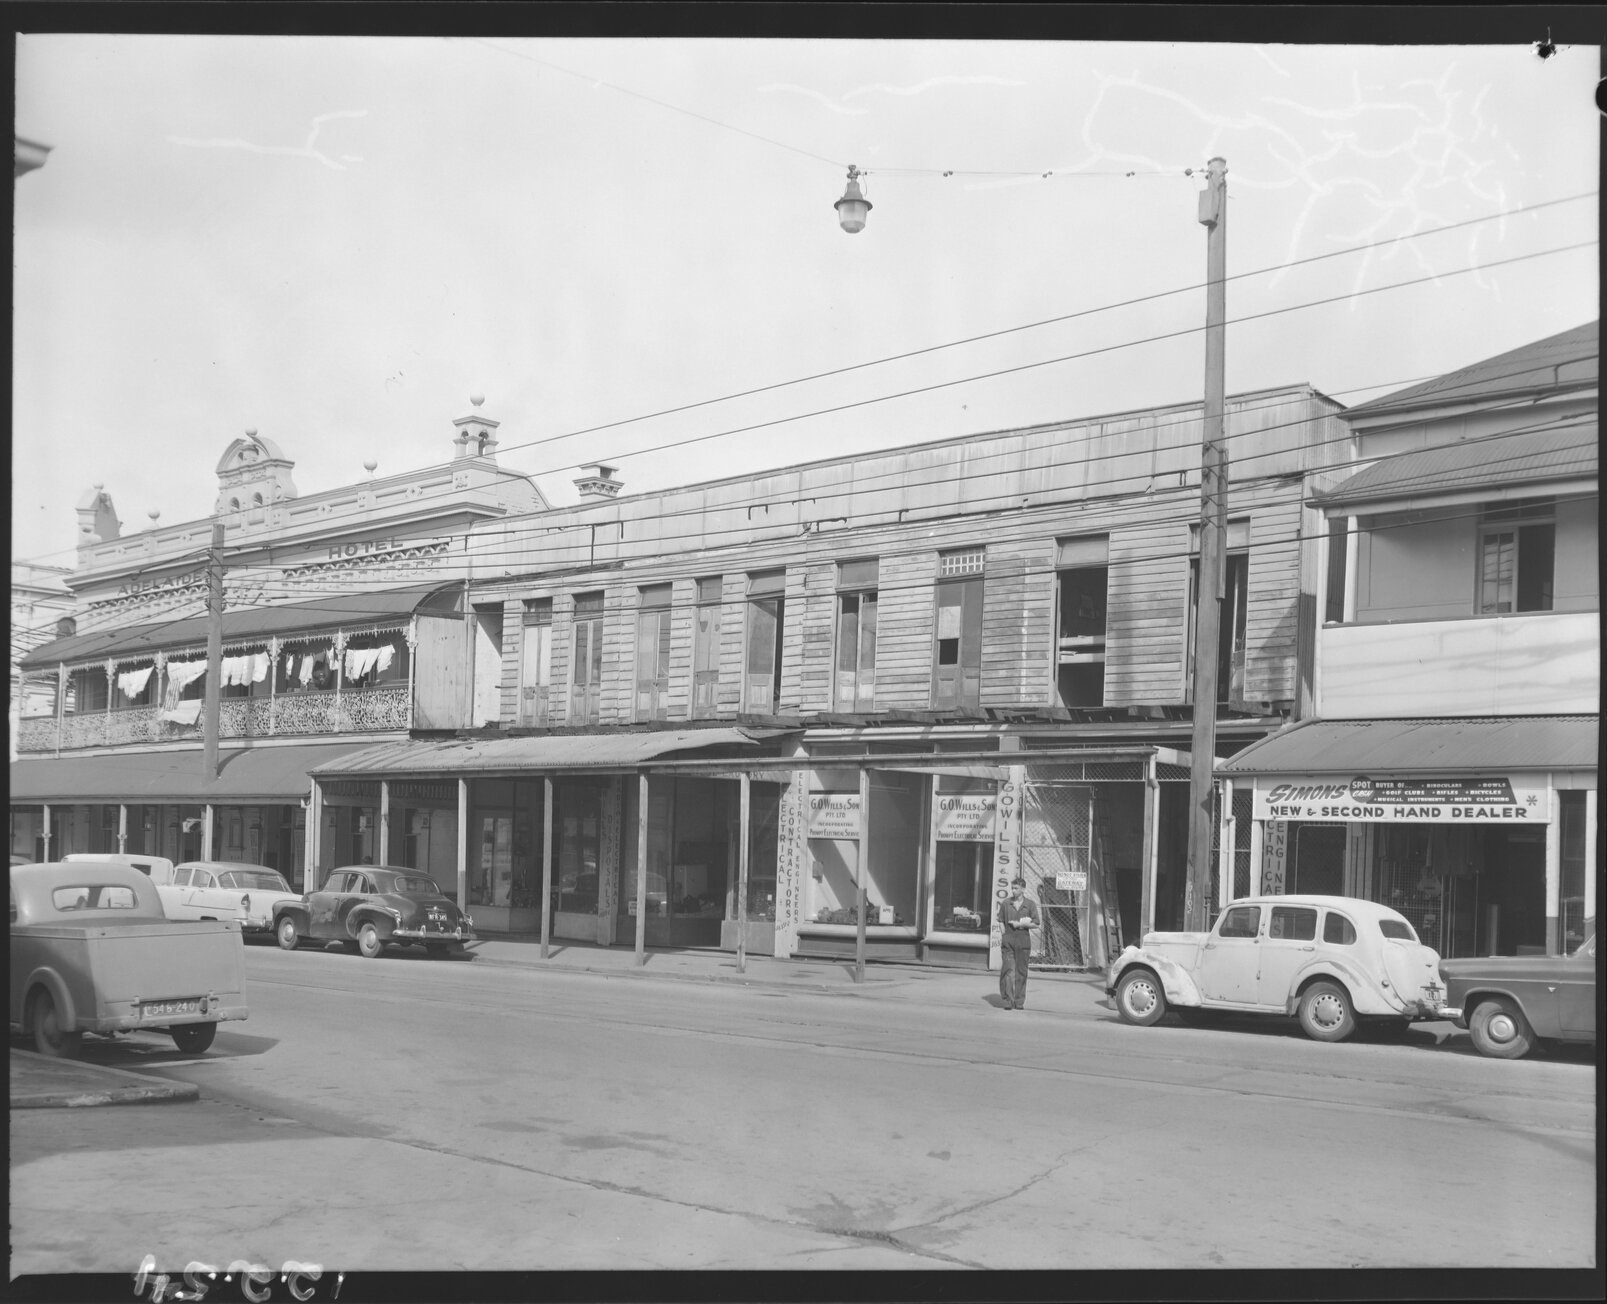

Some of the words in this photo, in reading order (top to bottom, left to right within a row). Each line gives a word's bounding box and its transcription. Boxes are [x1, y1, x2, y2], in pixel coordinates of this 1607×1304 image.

[329, 537, 403, 560] HOTEL
[118, 573, 201, 597] ADELAIDE
[1266, 784, 1348, 803] SIMONS
[1352, 780, 1371, 789] SPOT
[796, 772, 804, 849] ELECTRICAL
[1270, 806, 1302, 816] NEW
[1307, 808, 1317, 816] &
[1321, 806, 1384, 817] SECOND
[1394, 807, 1441, 818] HAND
[1452, 807, 1527, 818] DEALER
[779, 795, 787, 884] LECTRICAL
[785, 807, 794, 918] CONTRACTORS
[1264, 820, 1274, 895] CTRICA
